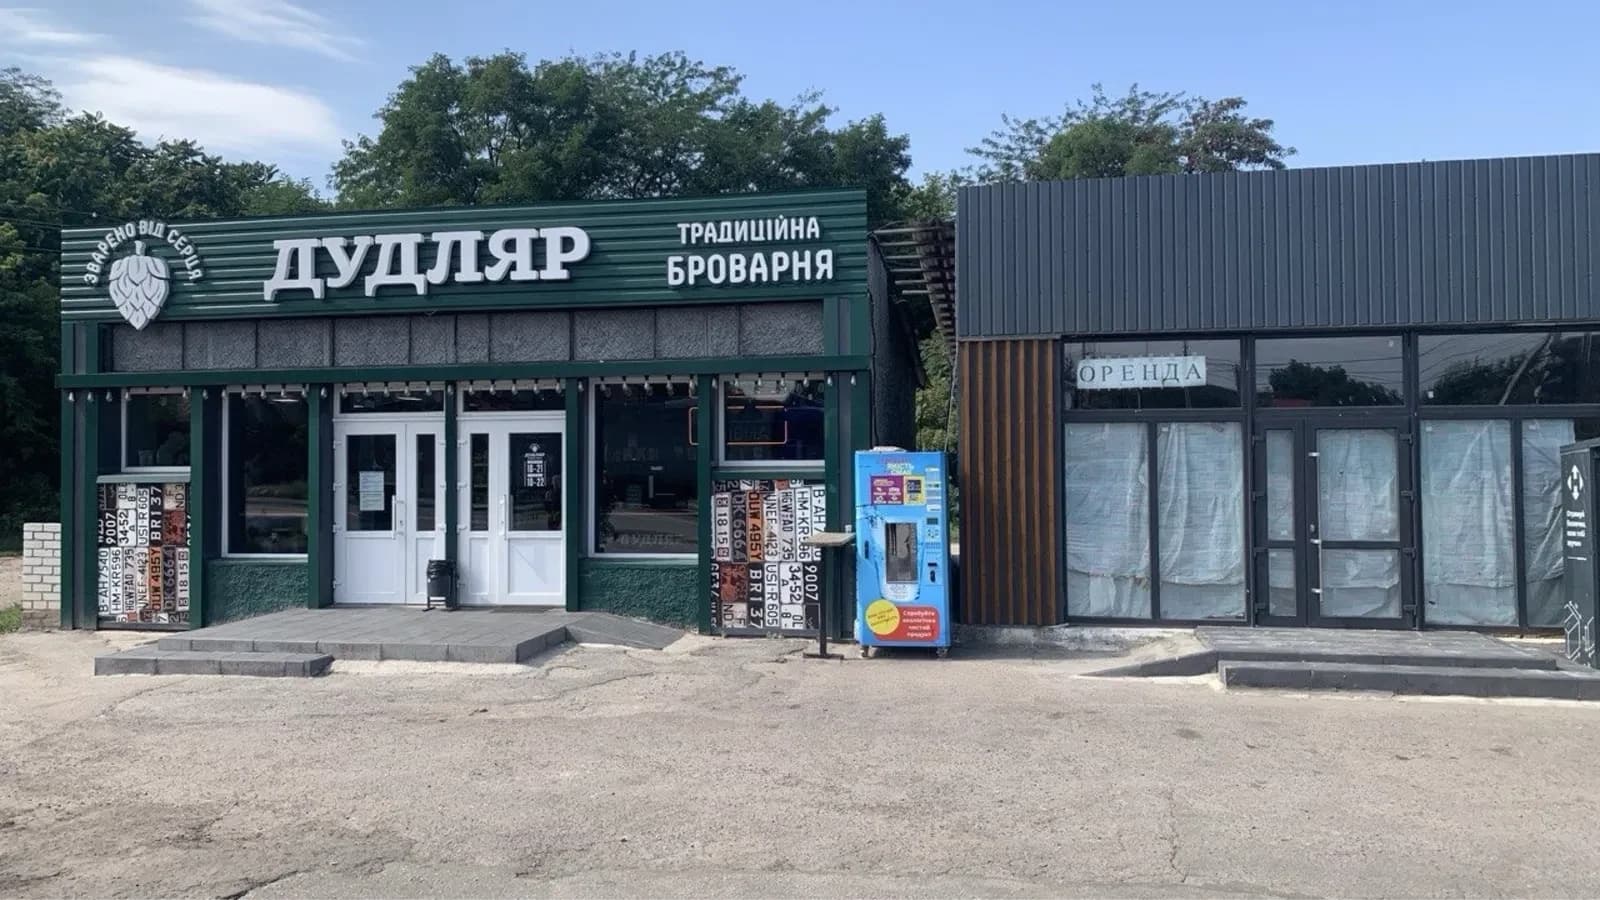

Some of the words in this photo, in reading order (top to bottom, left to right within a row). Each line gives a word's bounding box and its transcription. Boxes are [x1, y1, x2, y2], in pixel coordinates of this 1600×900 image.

[677, 214, 820, 245] ТРАДИЦІЙНА
[83, 222, 136, 284] ЗВАРЕНО
[138, 220, 166, 239] ВІД
[167, 229, 202, 280] СЕРЦЯ
[263, 226, 591, 301] ДУДЛЯР
[667, 249, 834, 286] БРОВАРНЯ
[1079, 363, 1202, 386] ОРЕНДА
[105, 512, 117, 545] 9007
[789, 565, 803, 602] 34-52
[805, 565, 818, 601] 9007
